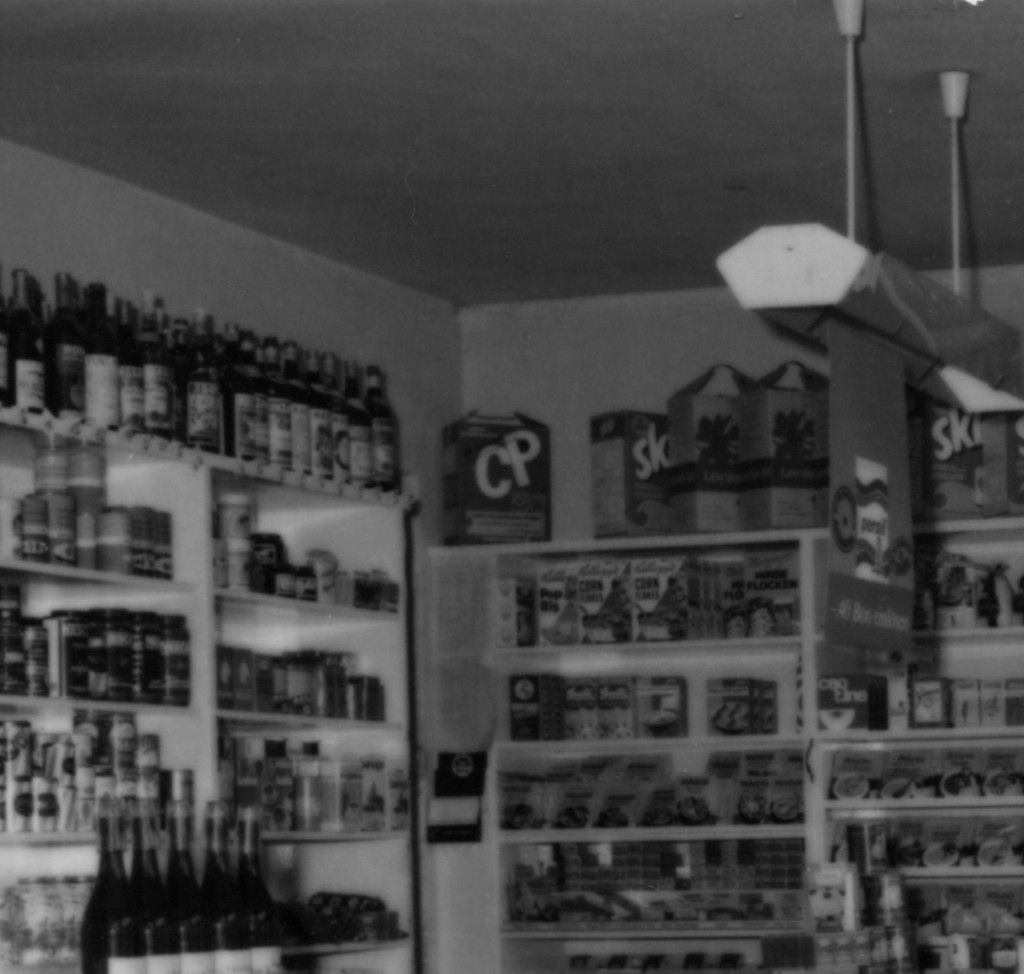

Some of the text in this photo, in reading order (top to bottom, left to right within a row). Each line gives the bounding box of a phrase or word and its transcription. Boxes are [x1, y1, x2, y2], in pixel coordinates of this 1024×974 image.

[475, 430, 541, 498] CP
[633, 422, 670, 482] Sk
[932, 407, 981, 461] Ski
